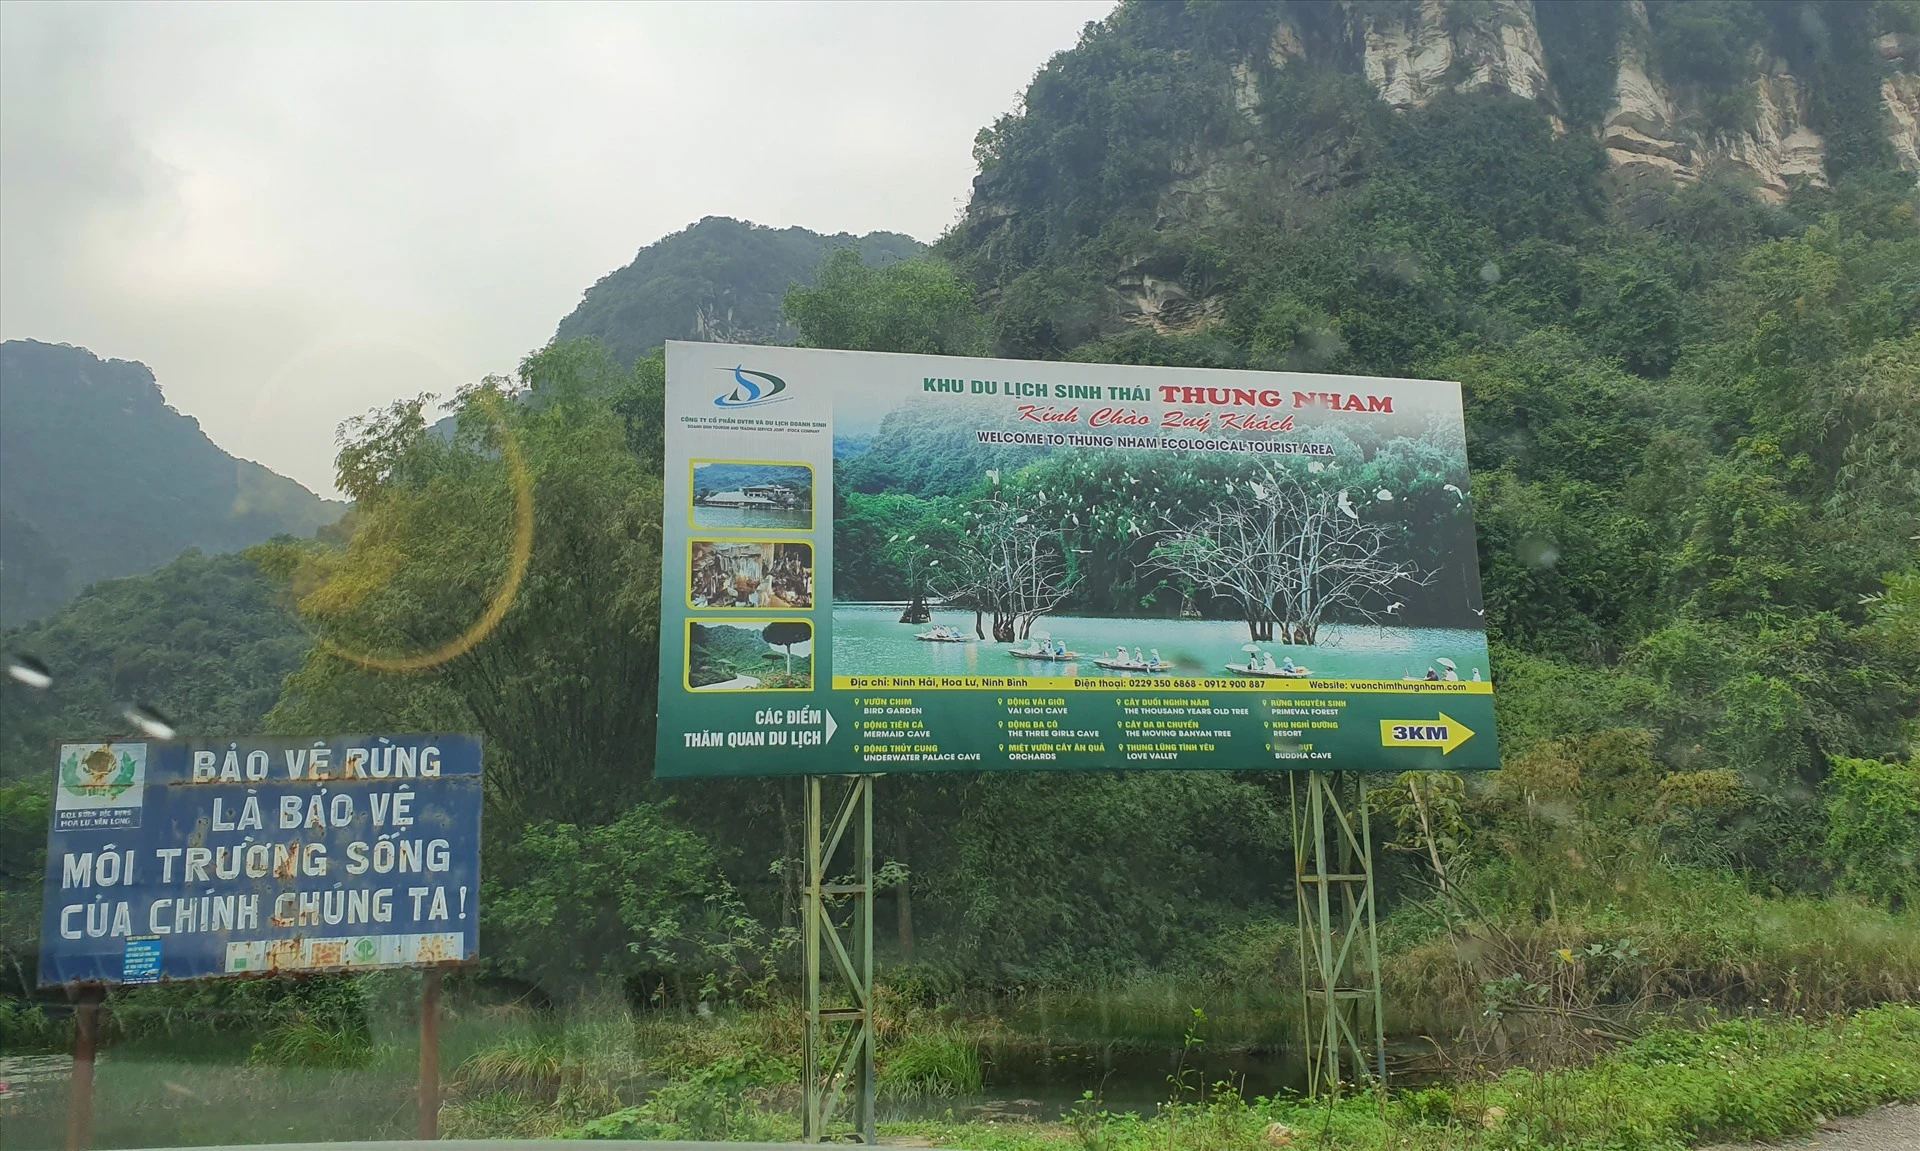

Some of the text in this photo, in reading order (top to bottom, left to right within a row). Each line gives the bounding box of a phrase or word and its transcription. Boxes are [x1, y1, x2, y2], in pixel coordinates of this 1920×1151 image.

[924, 378, 1393, 413] KHU DU LỊCH SINH THÁI THUNG NHAM
[1018, 405, 1294, 432] Kính Chào Quý Khách
[977, 432, 1334, 455] WELCOME TO THUNG NHAM ECOLOGICAL TOURIST AREA
[850, 678, 868, 688] Địa
[871, 677, 890, 687] chỉ:
[893, 678, 915, 687] Ninh
[919, 677, 939, 688] Hải,
[942, 679, 962, 687] Hoa
[966, 679, 979, 688] Lư,
[982, 679, 1004, 687] Ninh
[1007, 678, 1028, 687] Bình
[1075, 679, 1096, 689] Điện
[1099, 679, 1126, 689] thoại:
[1129, 680, 1152, 688] 0229
[1154, 680, 1170, 688] 350
[1174, 680, 1196, 688] 6868
[1204, 680, 1227, 688] 0912
[1230, 680, 1246, 688] 900
[1310, 681, 1348, 689] Website:
[1351, 682, 1467, 692] vuonchimthungnham.com
[864, 698, 912, 706] VƯỜN CHIM
[1007, 698, 1030, 706] ĐỘNG
[1124, 698, 1140, 706] CÂY
[1163, 698, 1189, 706] NGHÌN
[1191, 698, 1210, 706] NĂM
[1271, 699, 1293, 707] RỪNG
[1294, 699, 1326, 707] NGUYÊN
[755, 705, 821, 725] CÁC ĐIỂM
[864, 721, 888, 730] ĐỘNG
[890, 720, 910, 728] TIÊN
[1008, 720, 1031, 729] ĐỘNG
[1047, 720, 1058, 728] CÔ
[1126, 720, 1141, 728] CÂY
[1167, 719, 1199, 728] CHUYỂN
[1291, 720, 1310, 728] NGHỈ
[1312, 720, 1338, 729] DƯỠNG
[684, 730, 821, 748] THĂM QUAN DU LỊCH
[1392, 726, 1449, 740] 3KM
[864, 744, 888, 754] ĐỘNG
[890, 743, 912, 752] THỦY
[1009, 742, 1105, 752] MIỆT VƯỜN CÂY ĂN QUẢ
[1156, 743, 1177, 751] LŨNG
[1180, 743, 1197, 751] TÌNH
[1199, 743, 1214, 751] YÊU
[193, 737, 441, 787] BẢO VỆ RỪNG
[212, 784, 415, 832] LÀ BẢO VỆ
[62, 832, 450, 889] MÔI TRƯỜNG SỐNG
[61, 893, 132, 939] CỦA
[150, 888, 259, 934] CHÍNH
[273, 882, 393, 928] CHÚNG
